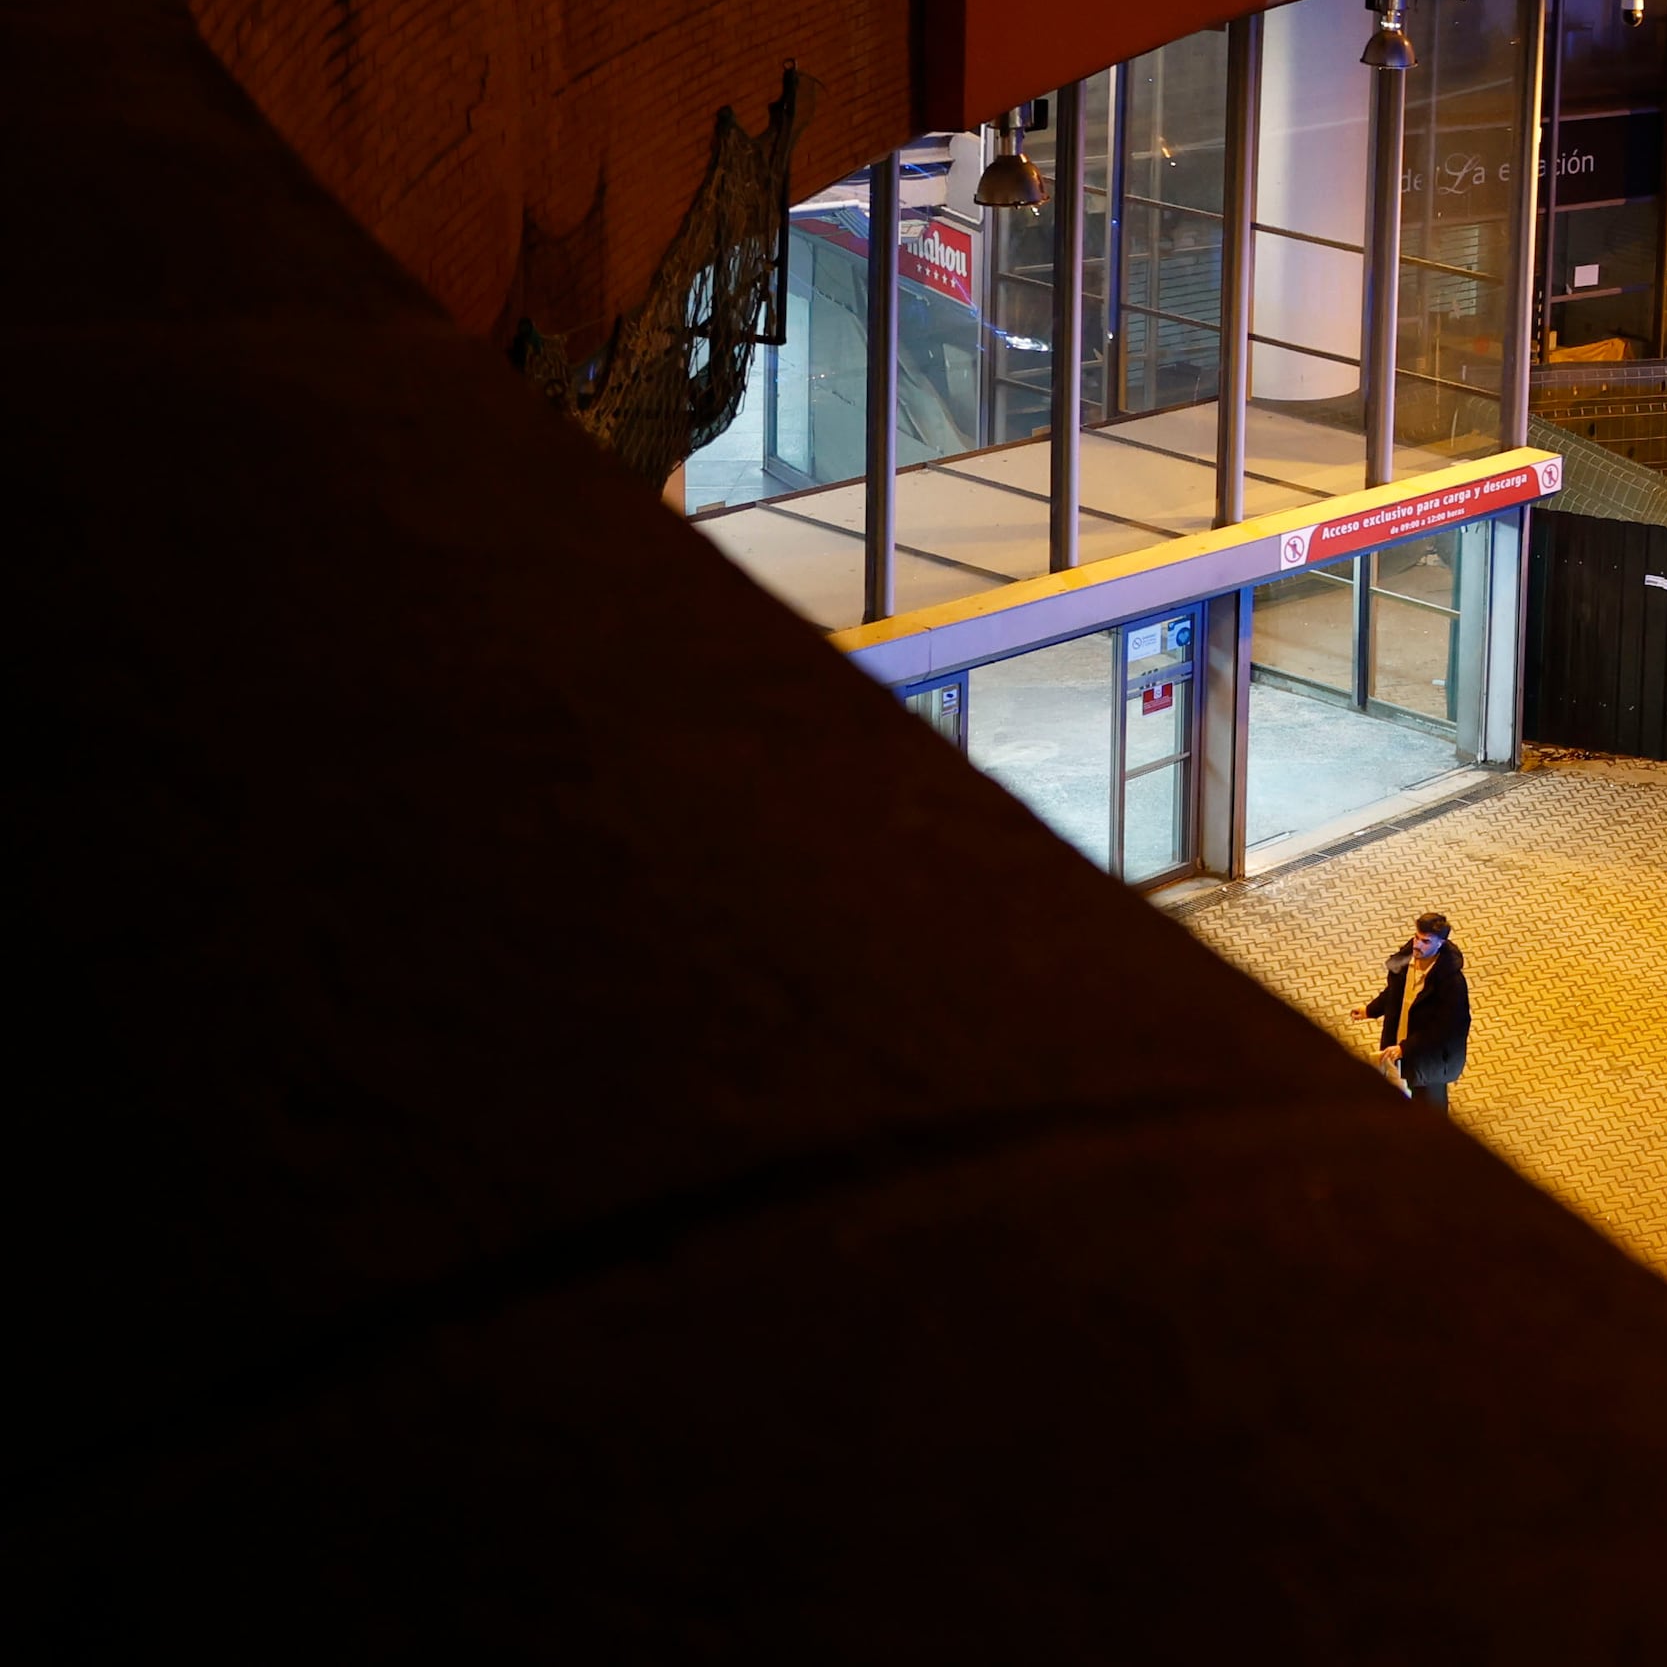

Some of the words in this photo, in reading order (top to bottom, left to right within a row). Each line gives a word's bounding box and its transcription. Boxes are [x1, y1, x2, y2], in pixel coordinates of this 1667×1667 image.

[1321, 517, 1360, 541] Acceso
[1362, 505, 1414, 528] exclusivo
[1416, 498, 1441, 521] para
[1443, 490, 1472, 508] carga
[1473, 488, 1481, 500] y
[1483, 473, 1528, 495] descarga
[1390, 525, 1400, 535] de
[1400, 520, 1420, 533] 09:00
[1427, 513, 1446, 526] 12:00
